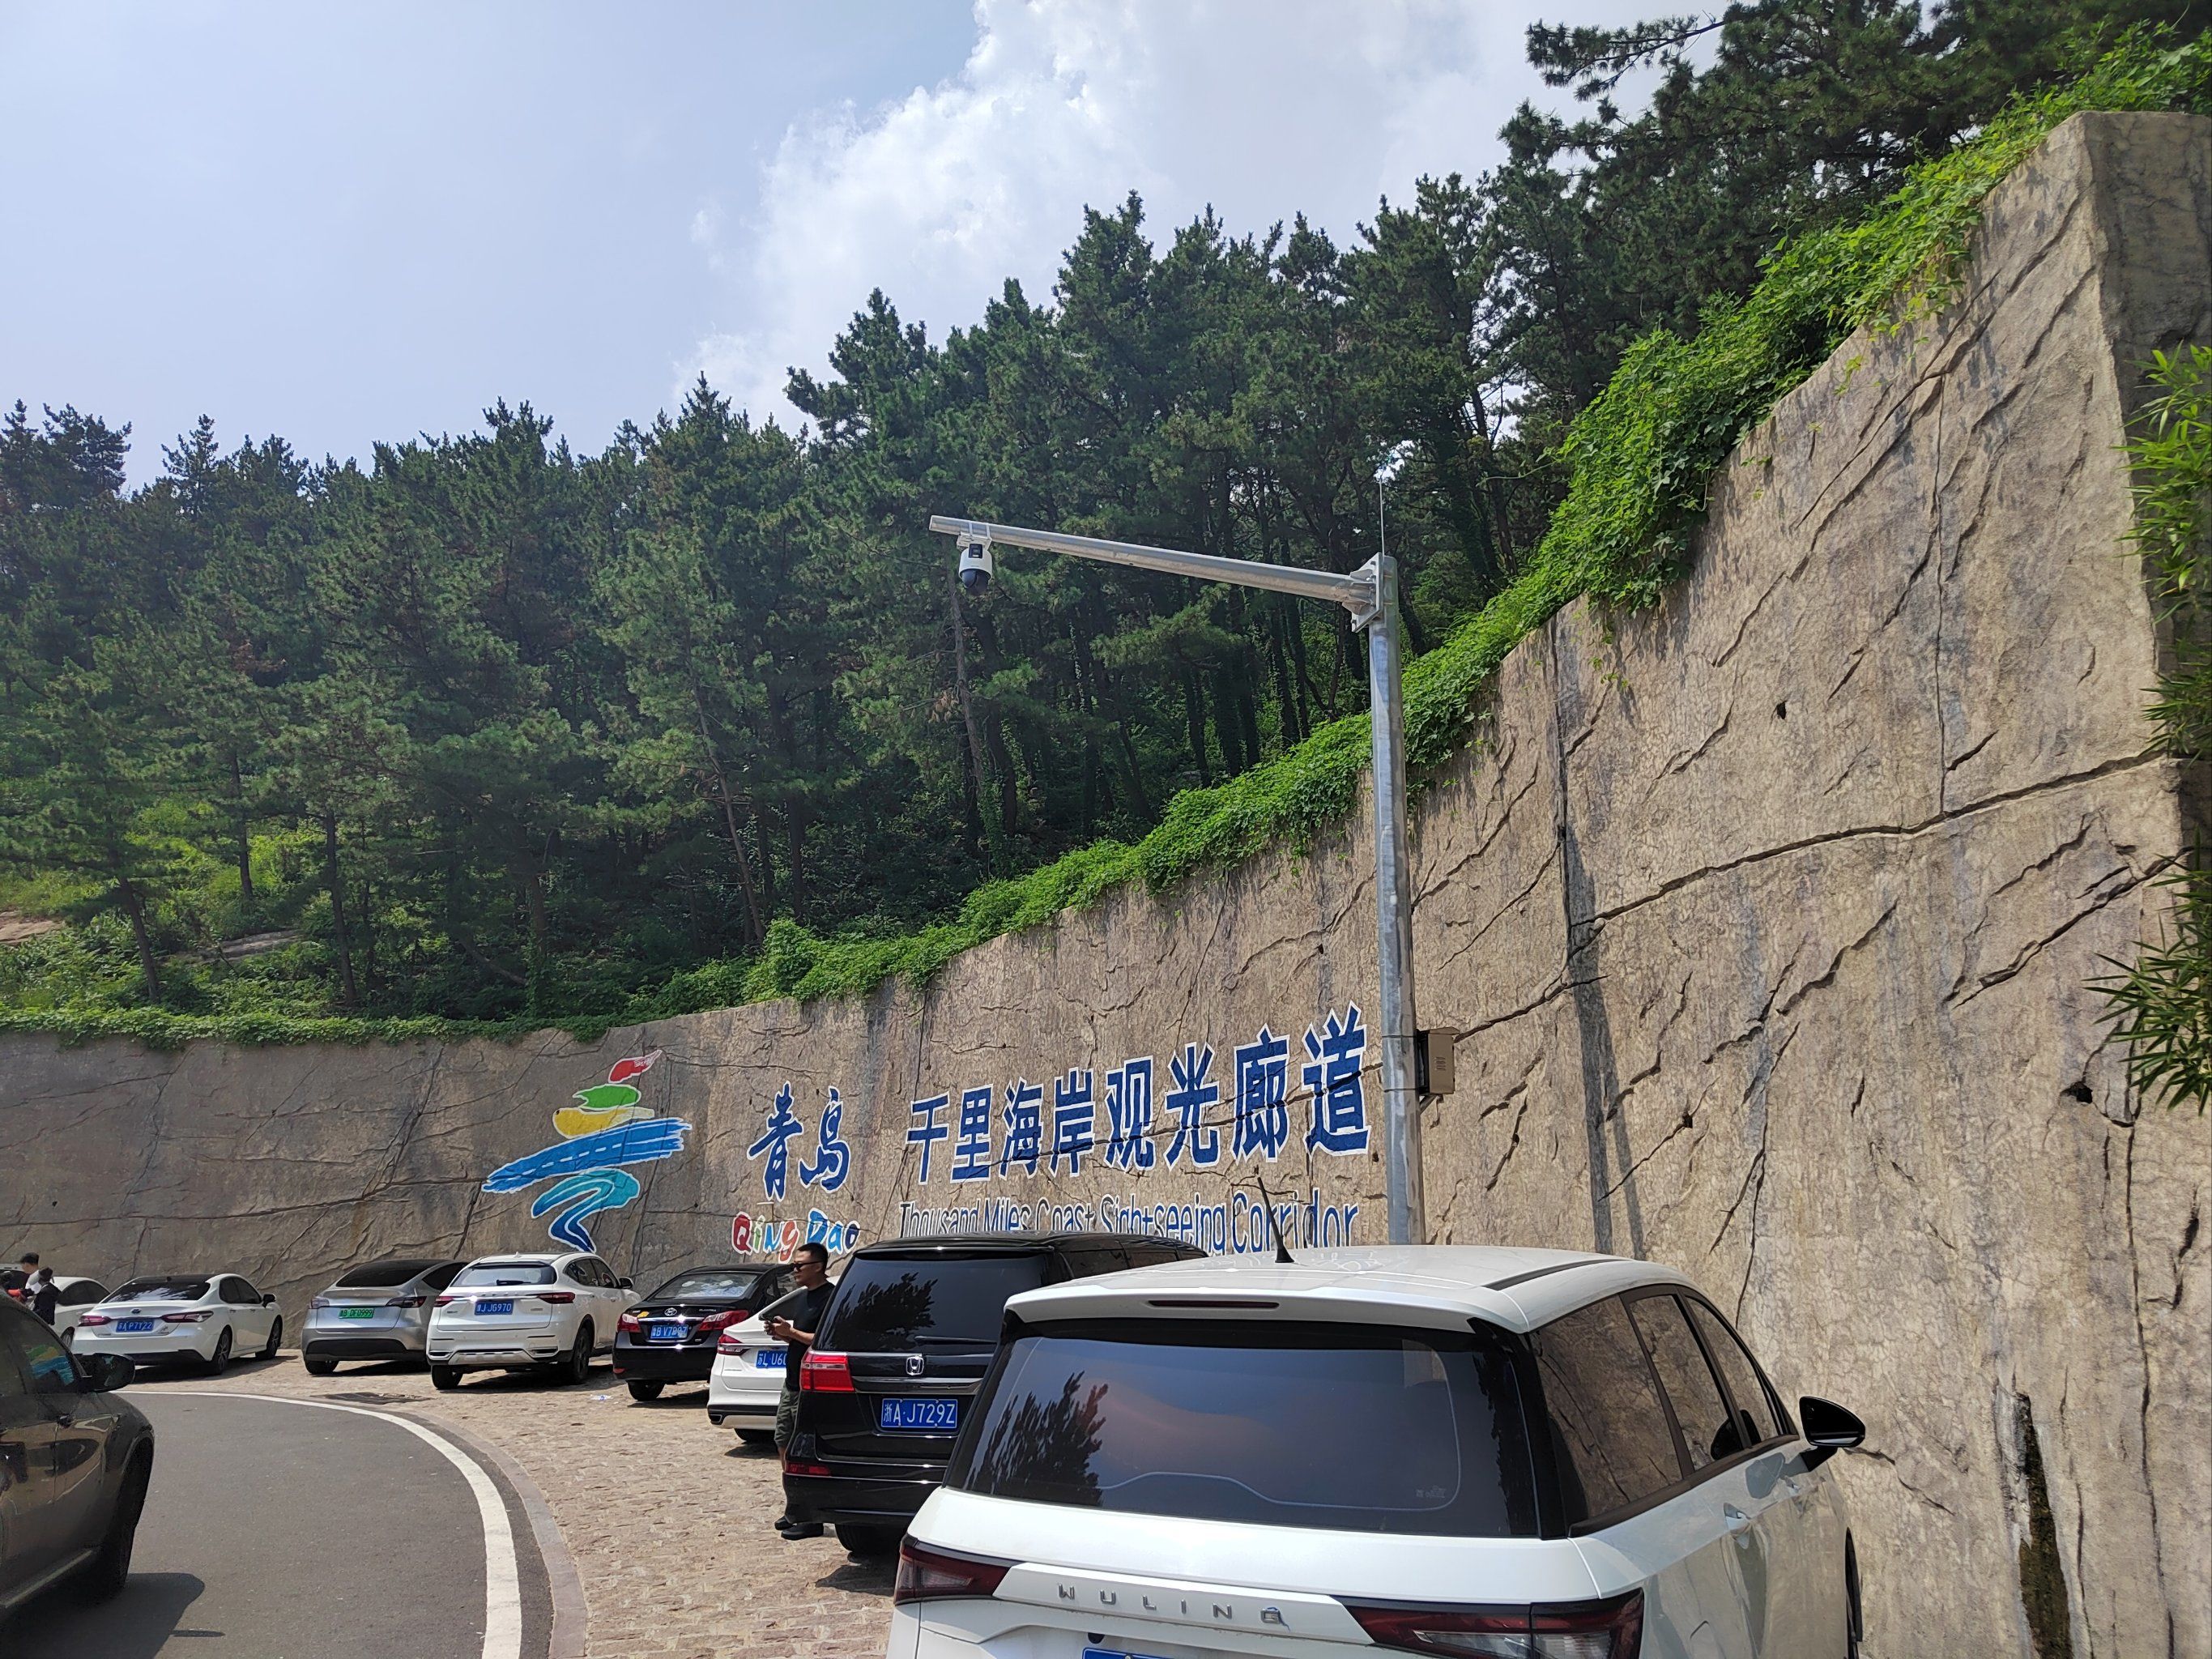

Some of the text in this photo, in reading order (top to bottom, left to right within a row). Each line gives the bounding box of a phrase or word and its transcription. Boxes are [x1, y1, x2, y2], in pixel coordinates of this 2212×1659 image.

[906, 1000, 1372, 1185] 千里海岸观光廊道
[747, 1081, 851, 1202] 青岛
[899, 1198, 981, 1238] Thousand
[983, 1196, 1031, 1231] Miles
[1035, 1196, 1095, 1231] Coast
[1230, 1187, 1359, 1254] Corridor
[1057, 1582, 1281, 1624] WULING
